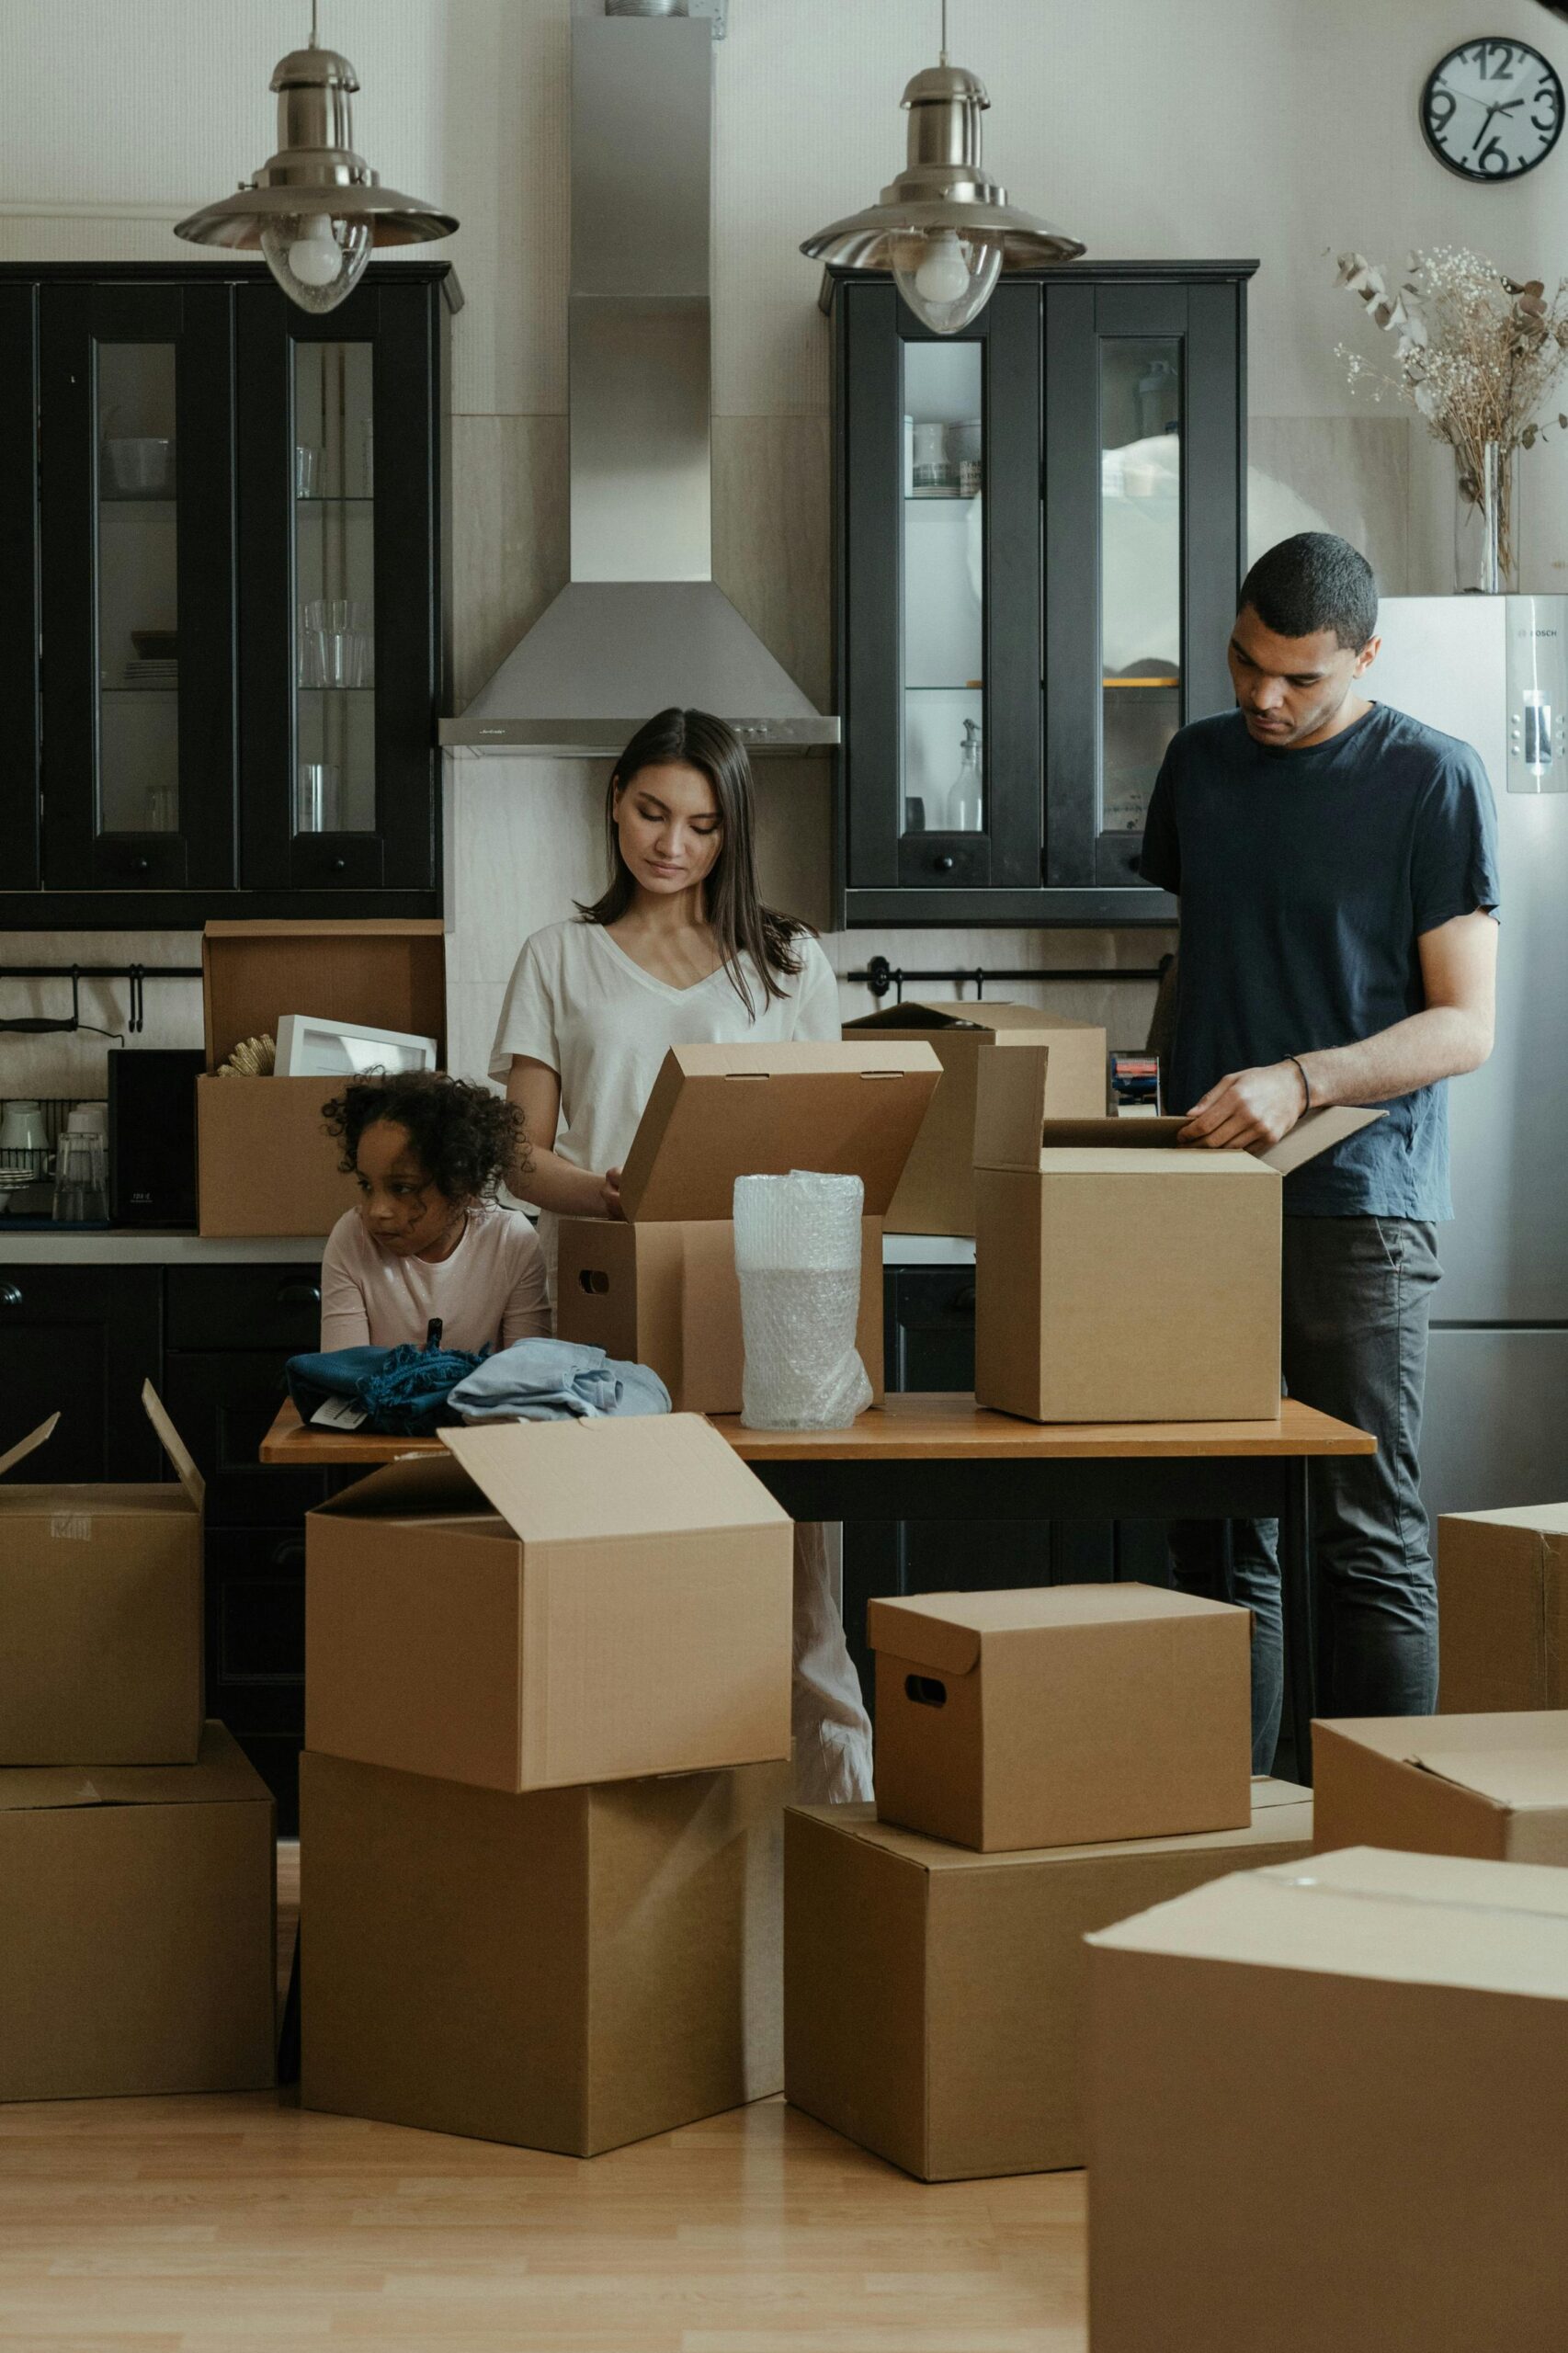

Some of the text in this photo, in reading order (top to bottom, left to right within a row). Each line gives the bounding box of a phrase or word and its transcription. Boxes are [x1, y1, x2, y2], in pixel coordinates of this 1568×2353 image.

[1472, 44, 1514, 80] 12
[1430, 89, 1457, 132] 9
[1530, 89, 1557, 131] 3
[1479, 136, 1509, 174] 6
